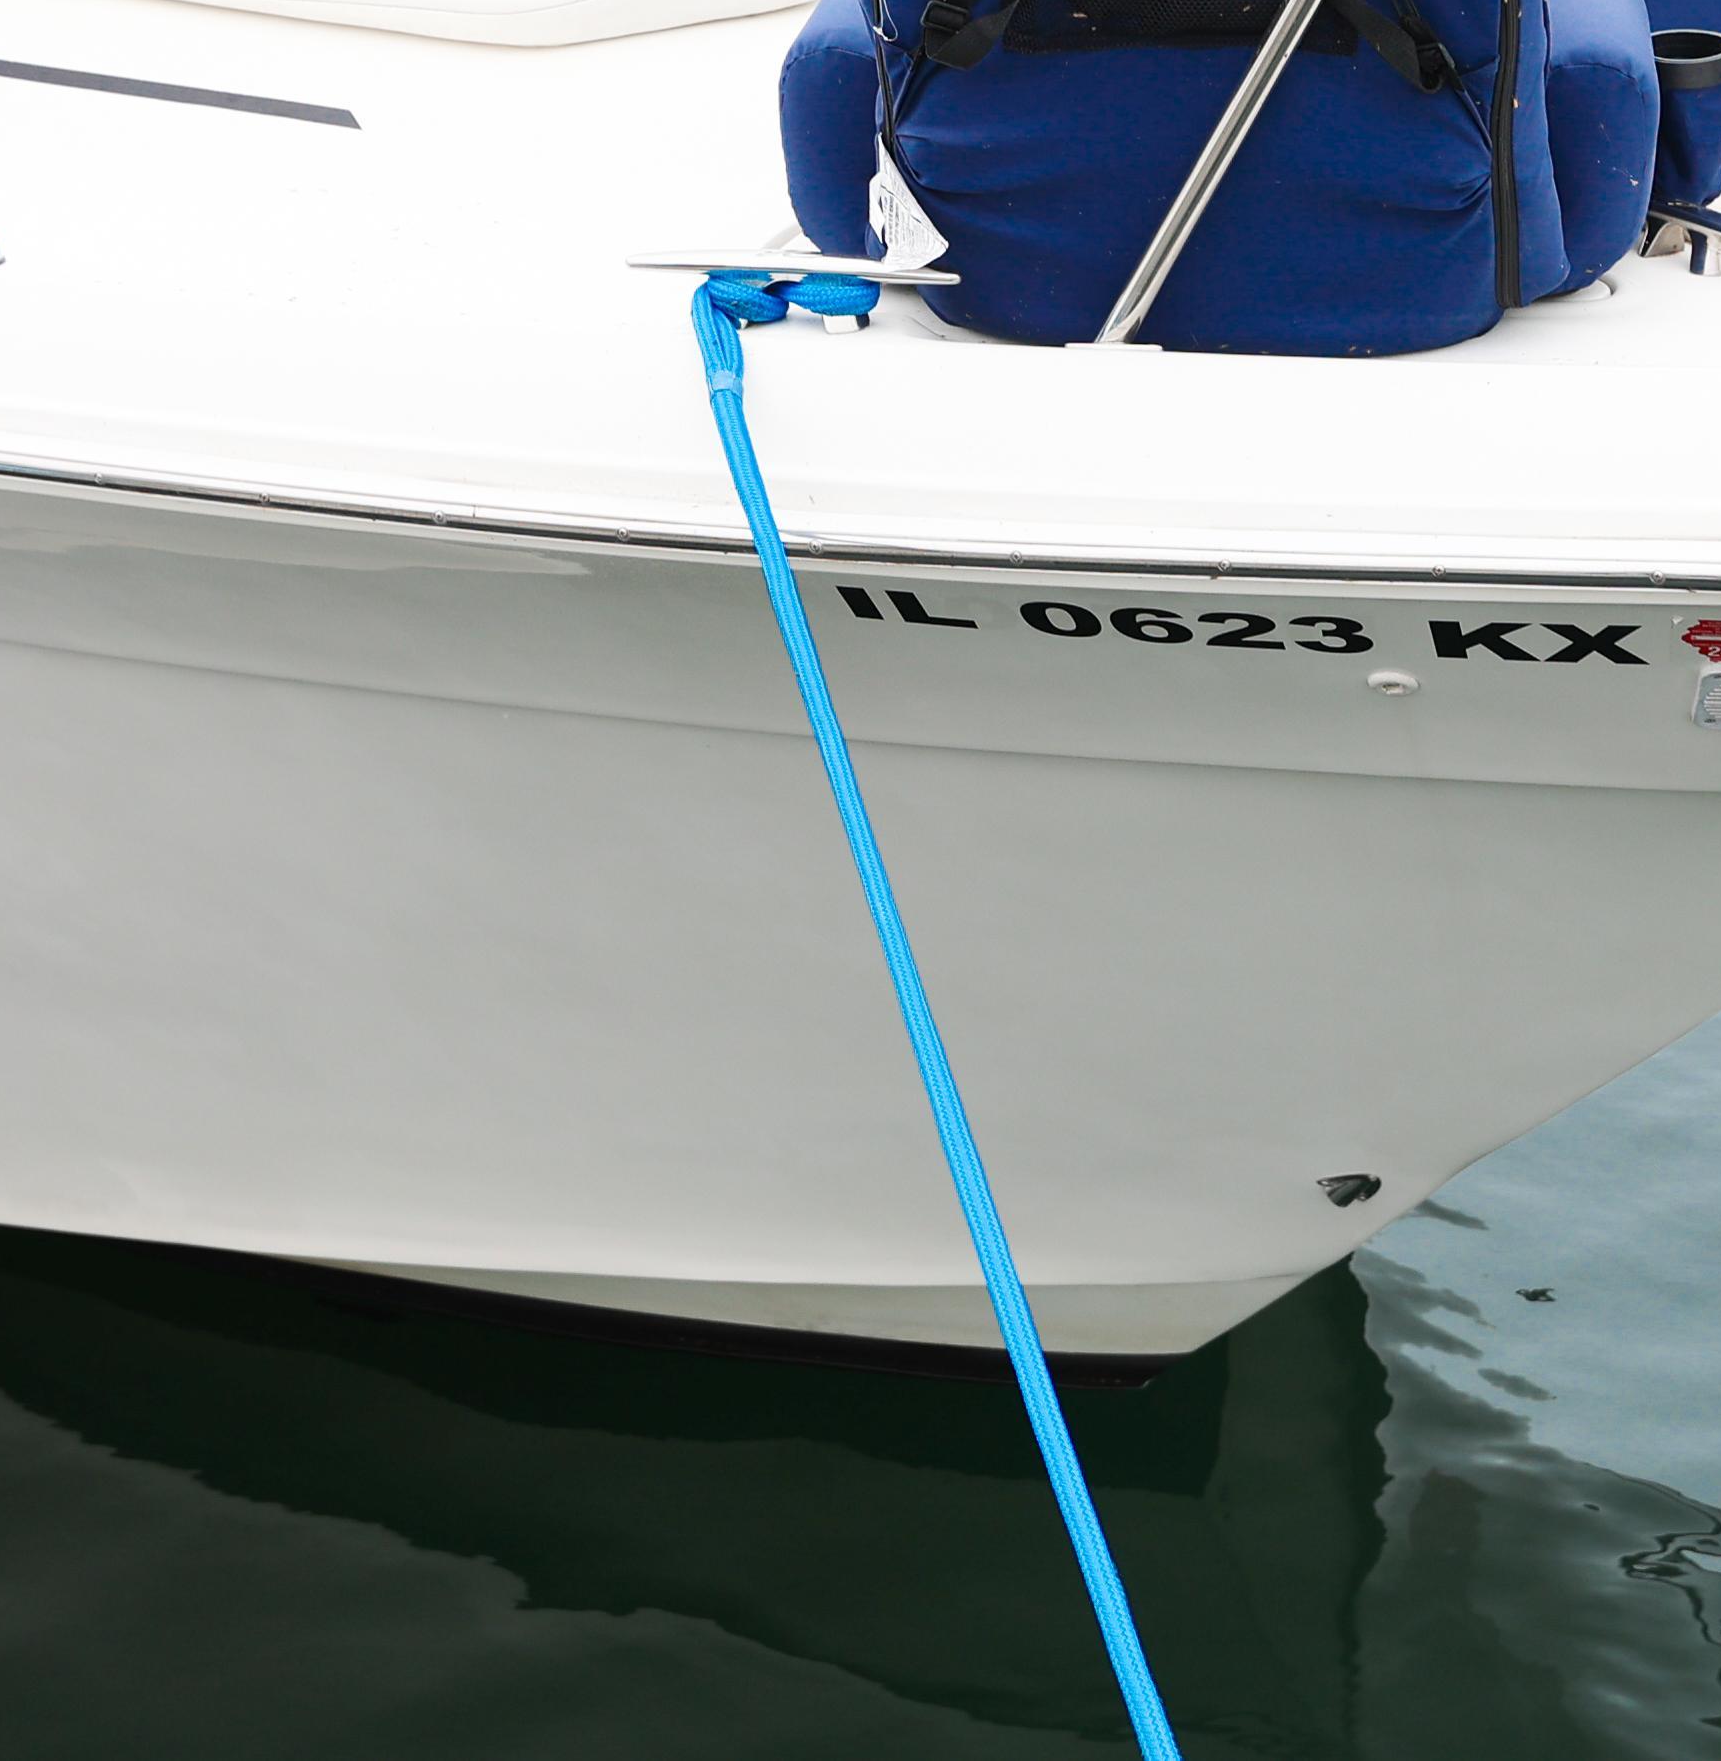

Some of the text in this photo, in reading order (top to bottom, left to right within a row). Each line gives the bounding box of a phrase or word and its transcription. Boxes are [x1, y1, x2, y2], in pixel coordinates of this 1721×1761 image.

[835, 585, 1651, 666] IL 0623 KX
